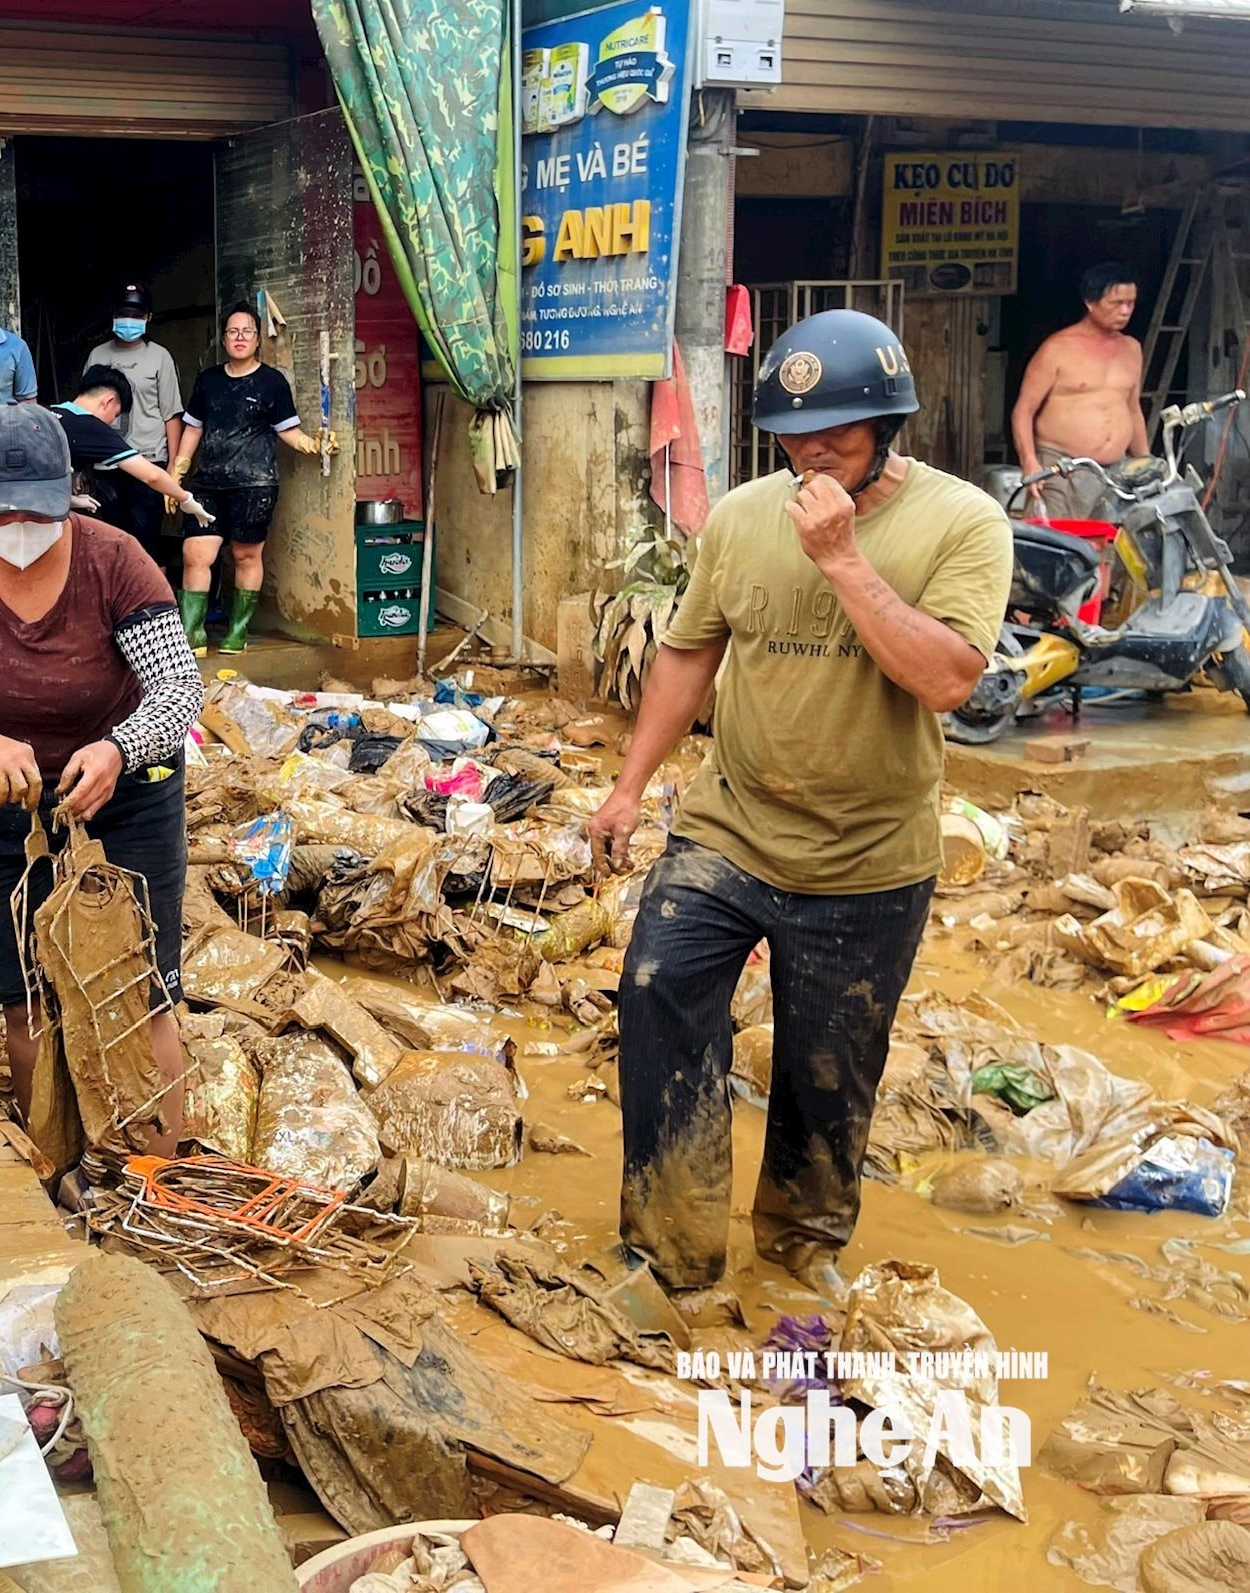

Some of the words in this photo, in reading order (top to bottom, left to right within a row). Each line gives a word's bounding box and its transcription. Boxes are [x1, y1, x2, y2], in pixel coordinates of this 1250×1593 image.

[606, 34, 649, 51] NUTRICARE
[536, 155, 570, 193] MẸ
[577, 141, 607, 182] VÀ
[612, 131, 650, 177] BÉ
[553, 199, 651, 263] ANH
[563, 282, 585, 296] SINH
[621, 277, 657, 291] TRANG
[544, 329, 570, 350] 216
[357, 427, 401, 477] inh
[746, 583, 854, 638] R.19
